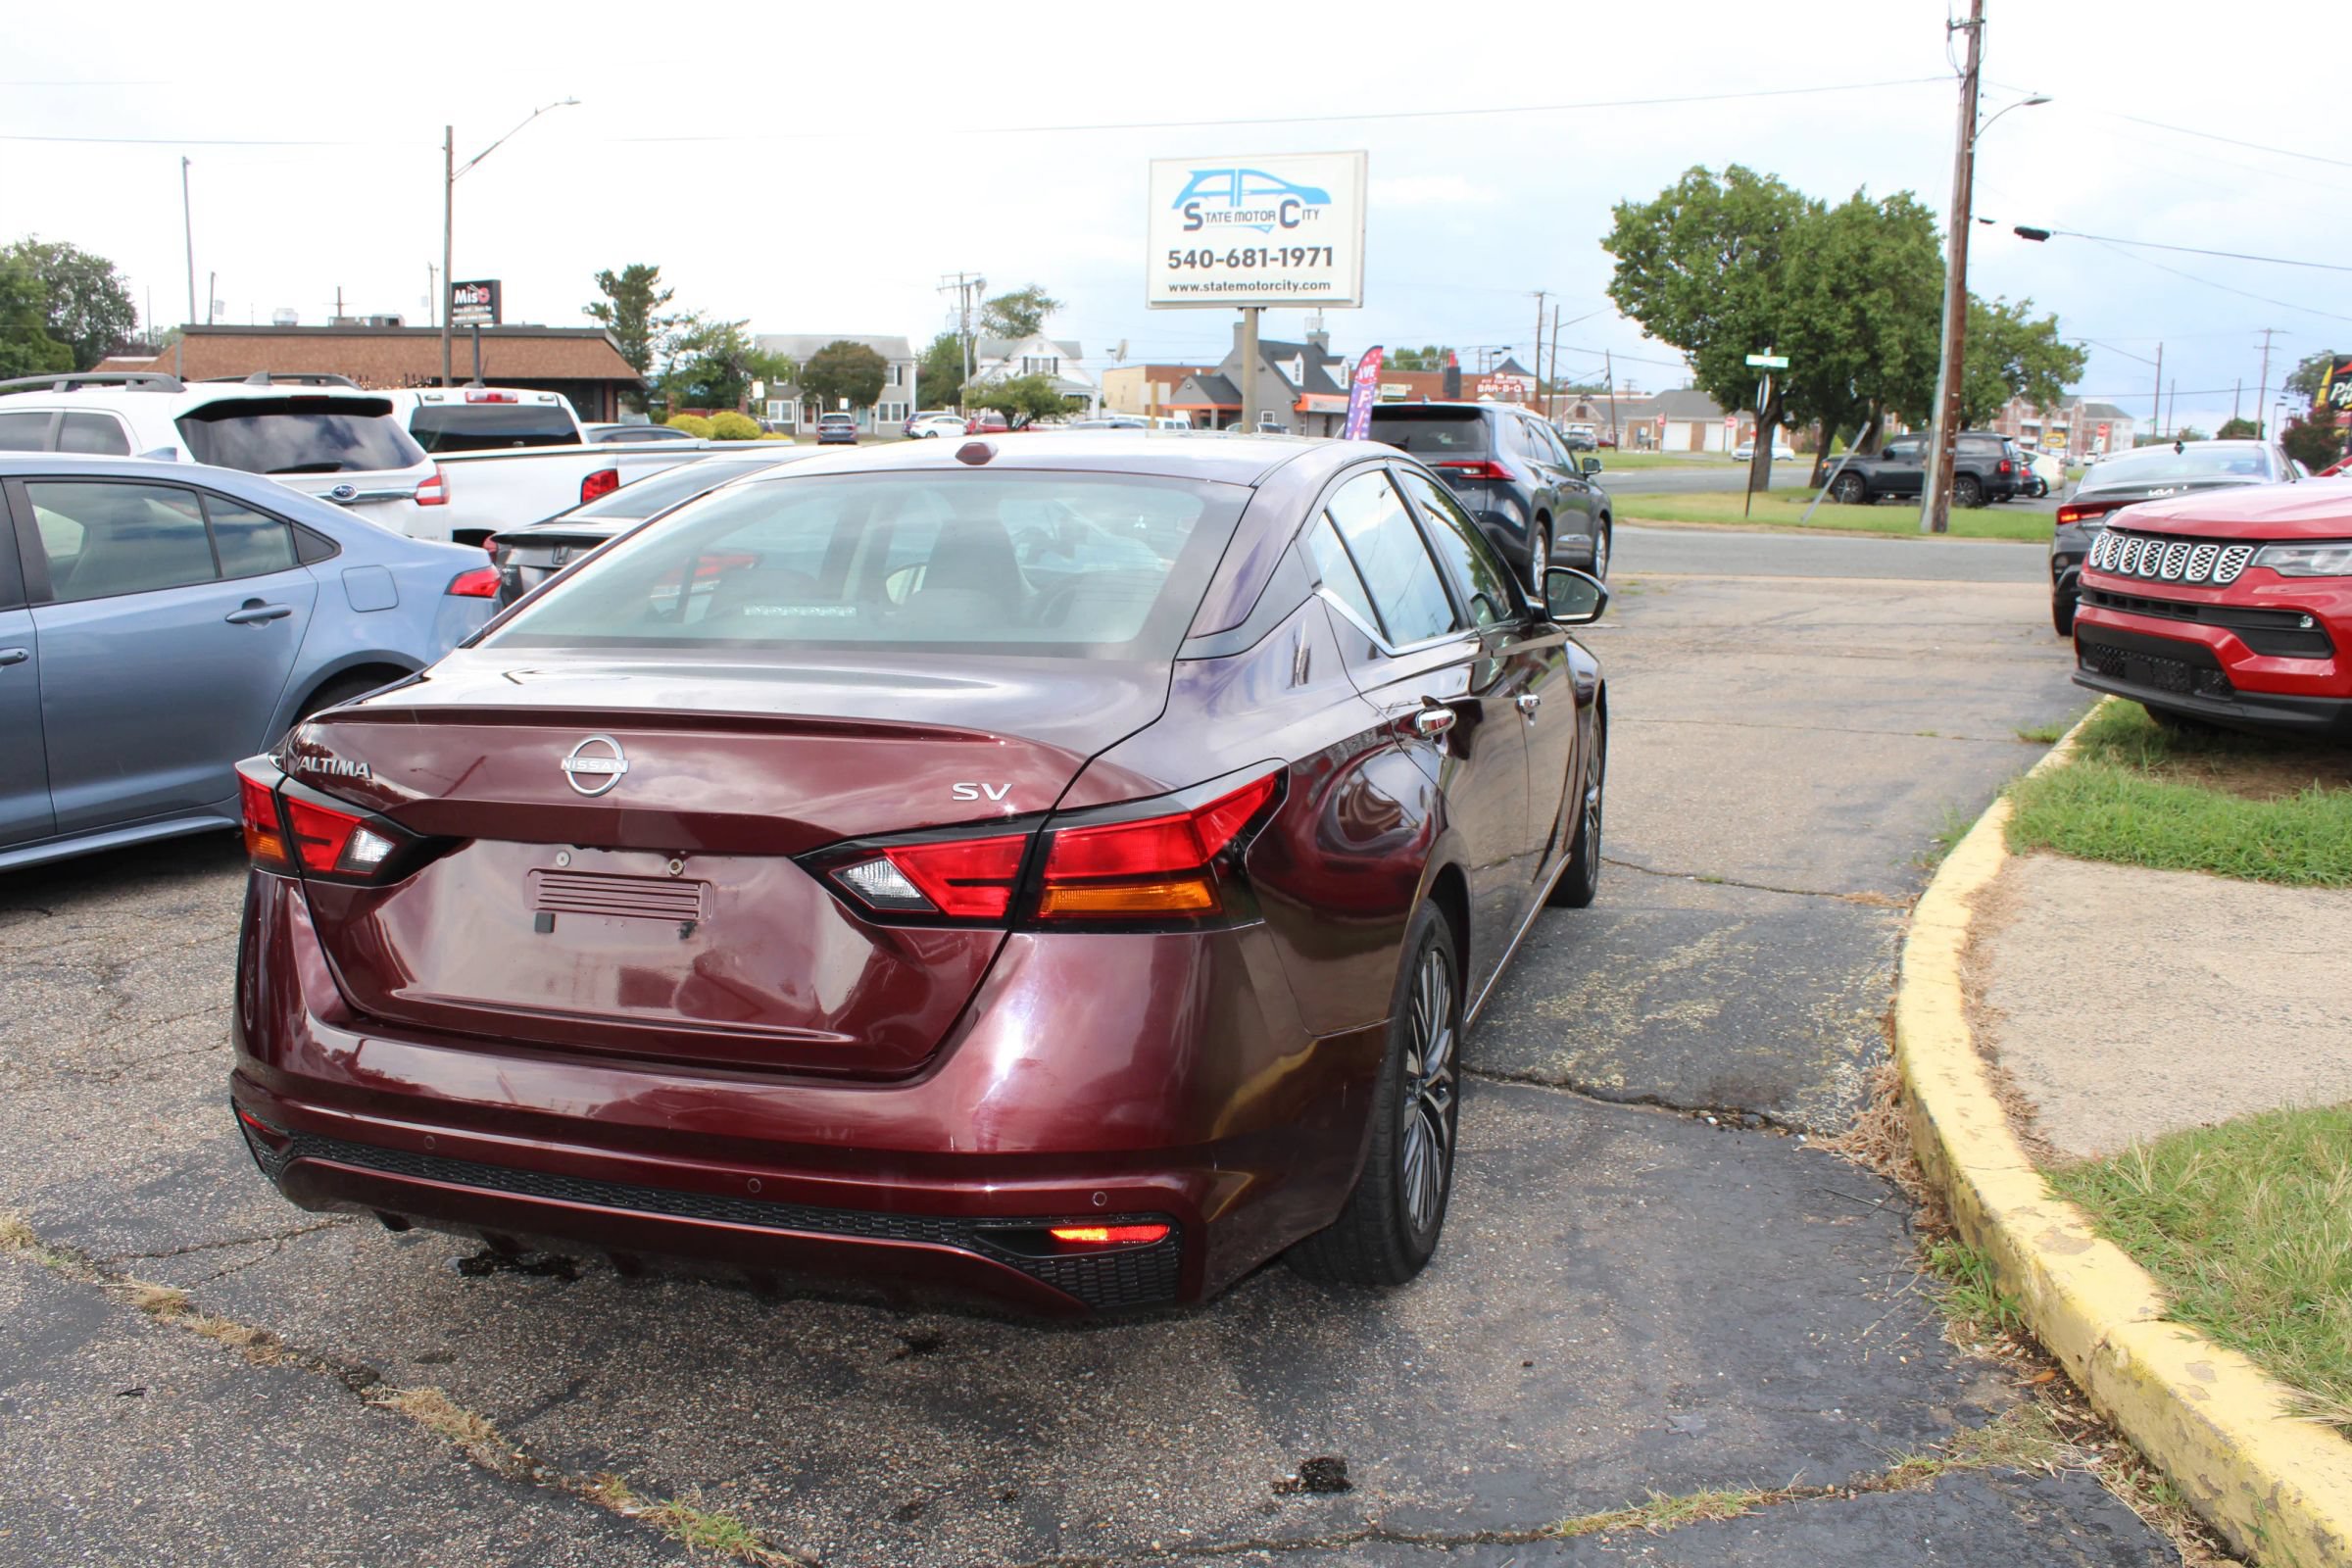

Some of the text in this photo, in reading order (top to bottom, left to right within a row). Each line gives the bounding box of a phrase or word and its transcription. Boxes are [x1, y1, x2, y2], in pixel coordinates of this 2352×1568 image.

[1184, 199, 1320, 231] STATE MOTOR CITY
[1168, 247, 1333, 270] 540-681-1971
[1168, 279, 1331, 293] www.statemotorcity.com
[296, 756, 370, 778] ALTIMA
[562, 759, 627, 772] NISSAN
[952, 782, 1012, 801] SV
